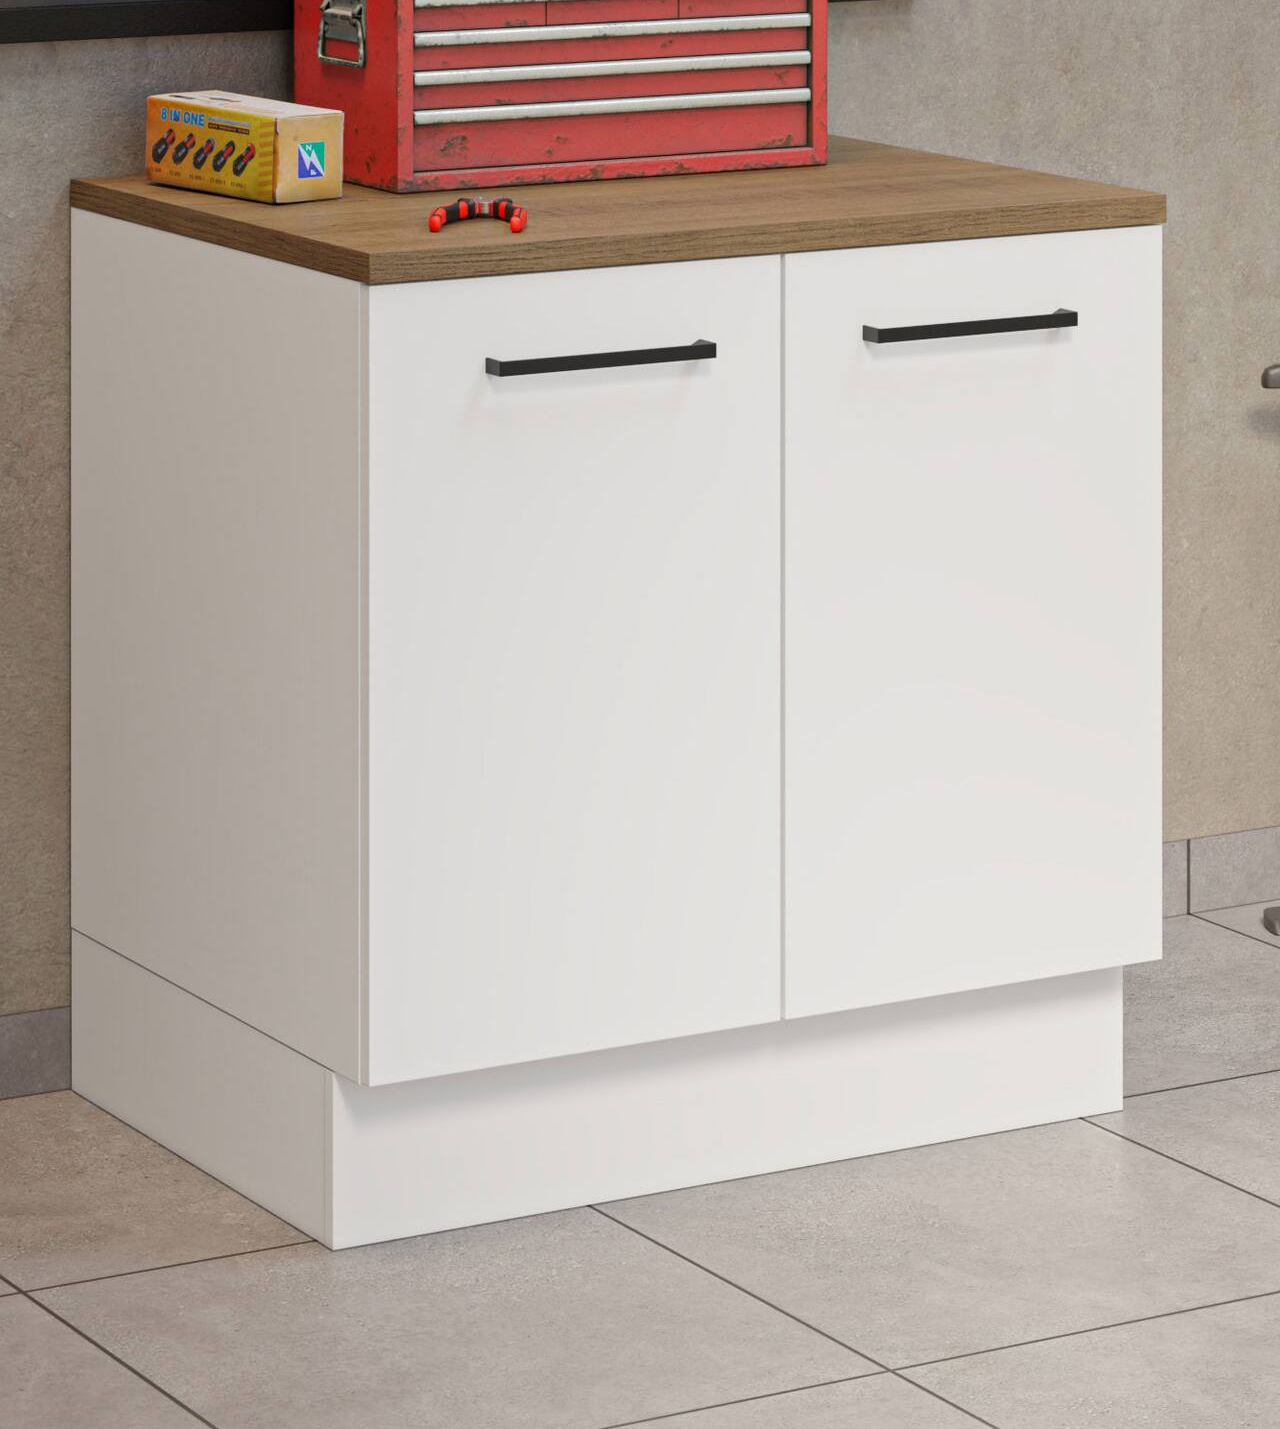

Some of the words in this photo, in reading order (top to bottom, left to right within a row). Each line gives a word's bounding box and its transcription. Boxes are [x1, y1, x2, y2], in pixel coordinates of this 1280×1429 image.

[161, 107, 168, 121] 8
[169, 108, 181, 123] IN
[183, 110, 206, 128] ONE
